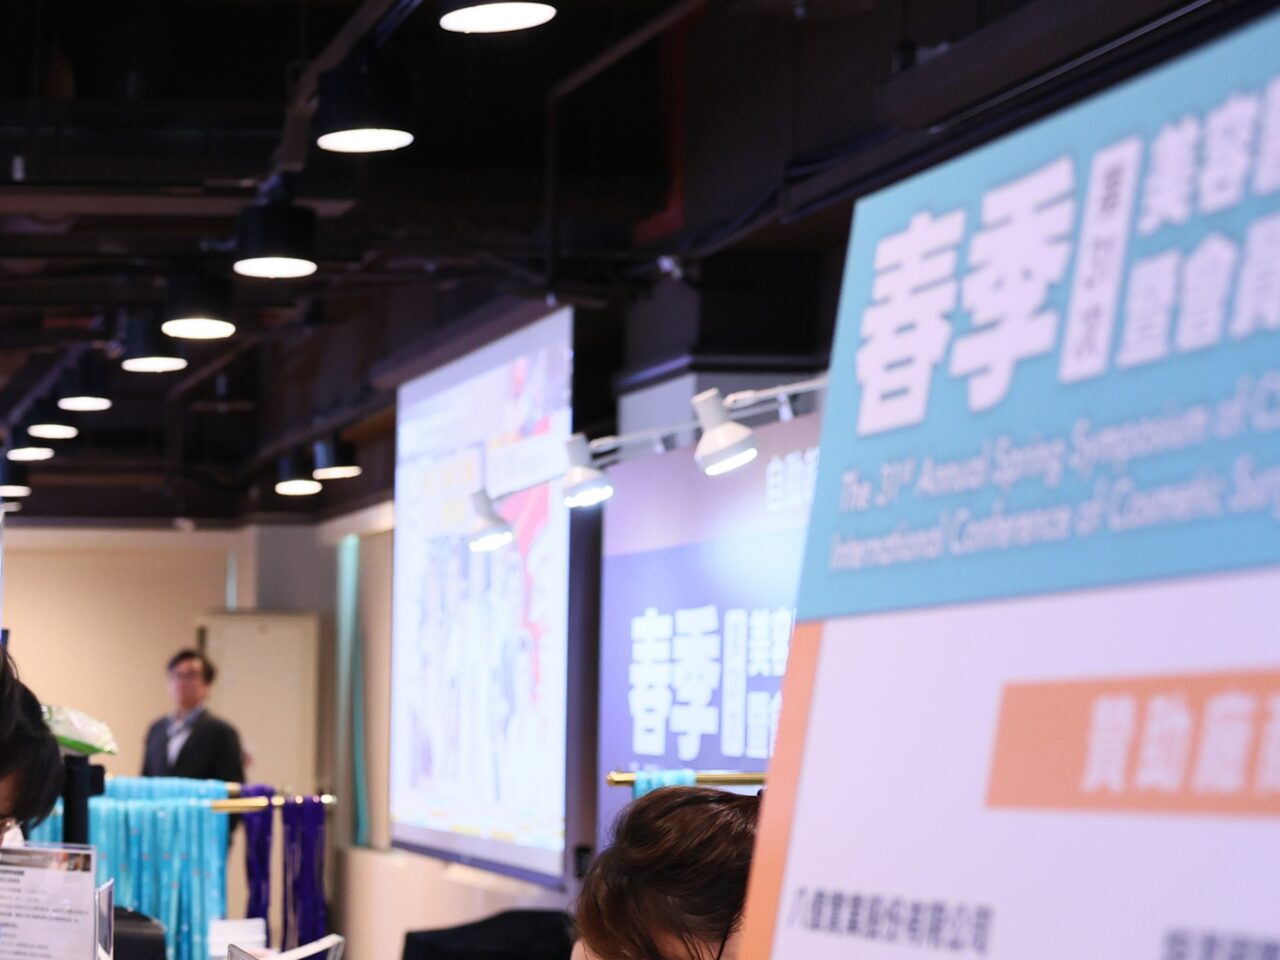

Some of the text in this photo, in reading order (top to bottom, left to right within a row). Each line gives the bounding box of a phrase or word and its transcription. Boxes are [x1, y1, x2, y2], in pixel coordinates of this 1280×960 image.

[855, 155, 1075, 437] 春季
[840, 470, 871, 512] The
[917, 440, 992, 496] Annual
[992, 434, 1068, 492] Spring
[1070, 403, 1210, 479] Symposium
[1214, 374, 1252, 438] of
[830, 512, 948, 571] International
[949, 497, 1072, 557] Conference
[1074, 477, 1108, 537] of
[628, 603, 721, 761] 春季
